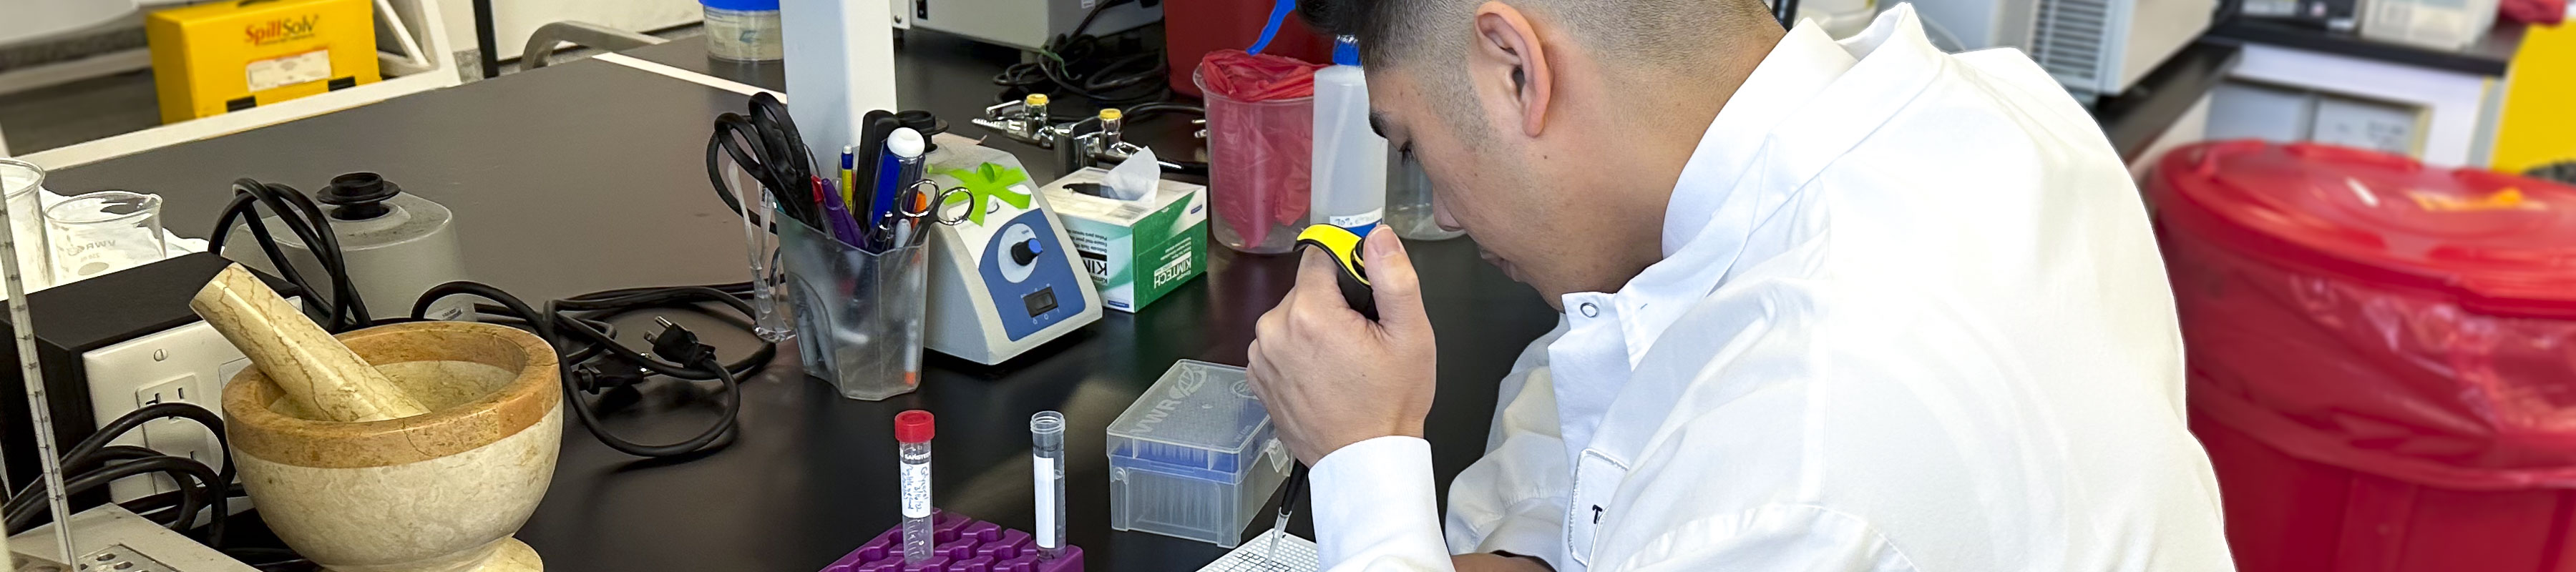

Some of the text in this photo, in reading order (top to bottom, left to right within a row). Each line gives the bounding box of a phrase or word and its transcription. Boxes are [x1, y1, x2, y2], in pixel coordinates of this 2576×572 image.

[245, 14, 319, 46] SpillSolv
[1153, 257, 1192, 289] KIMTECH
[1129, 399, 1181, 435] VWR
